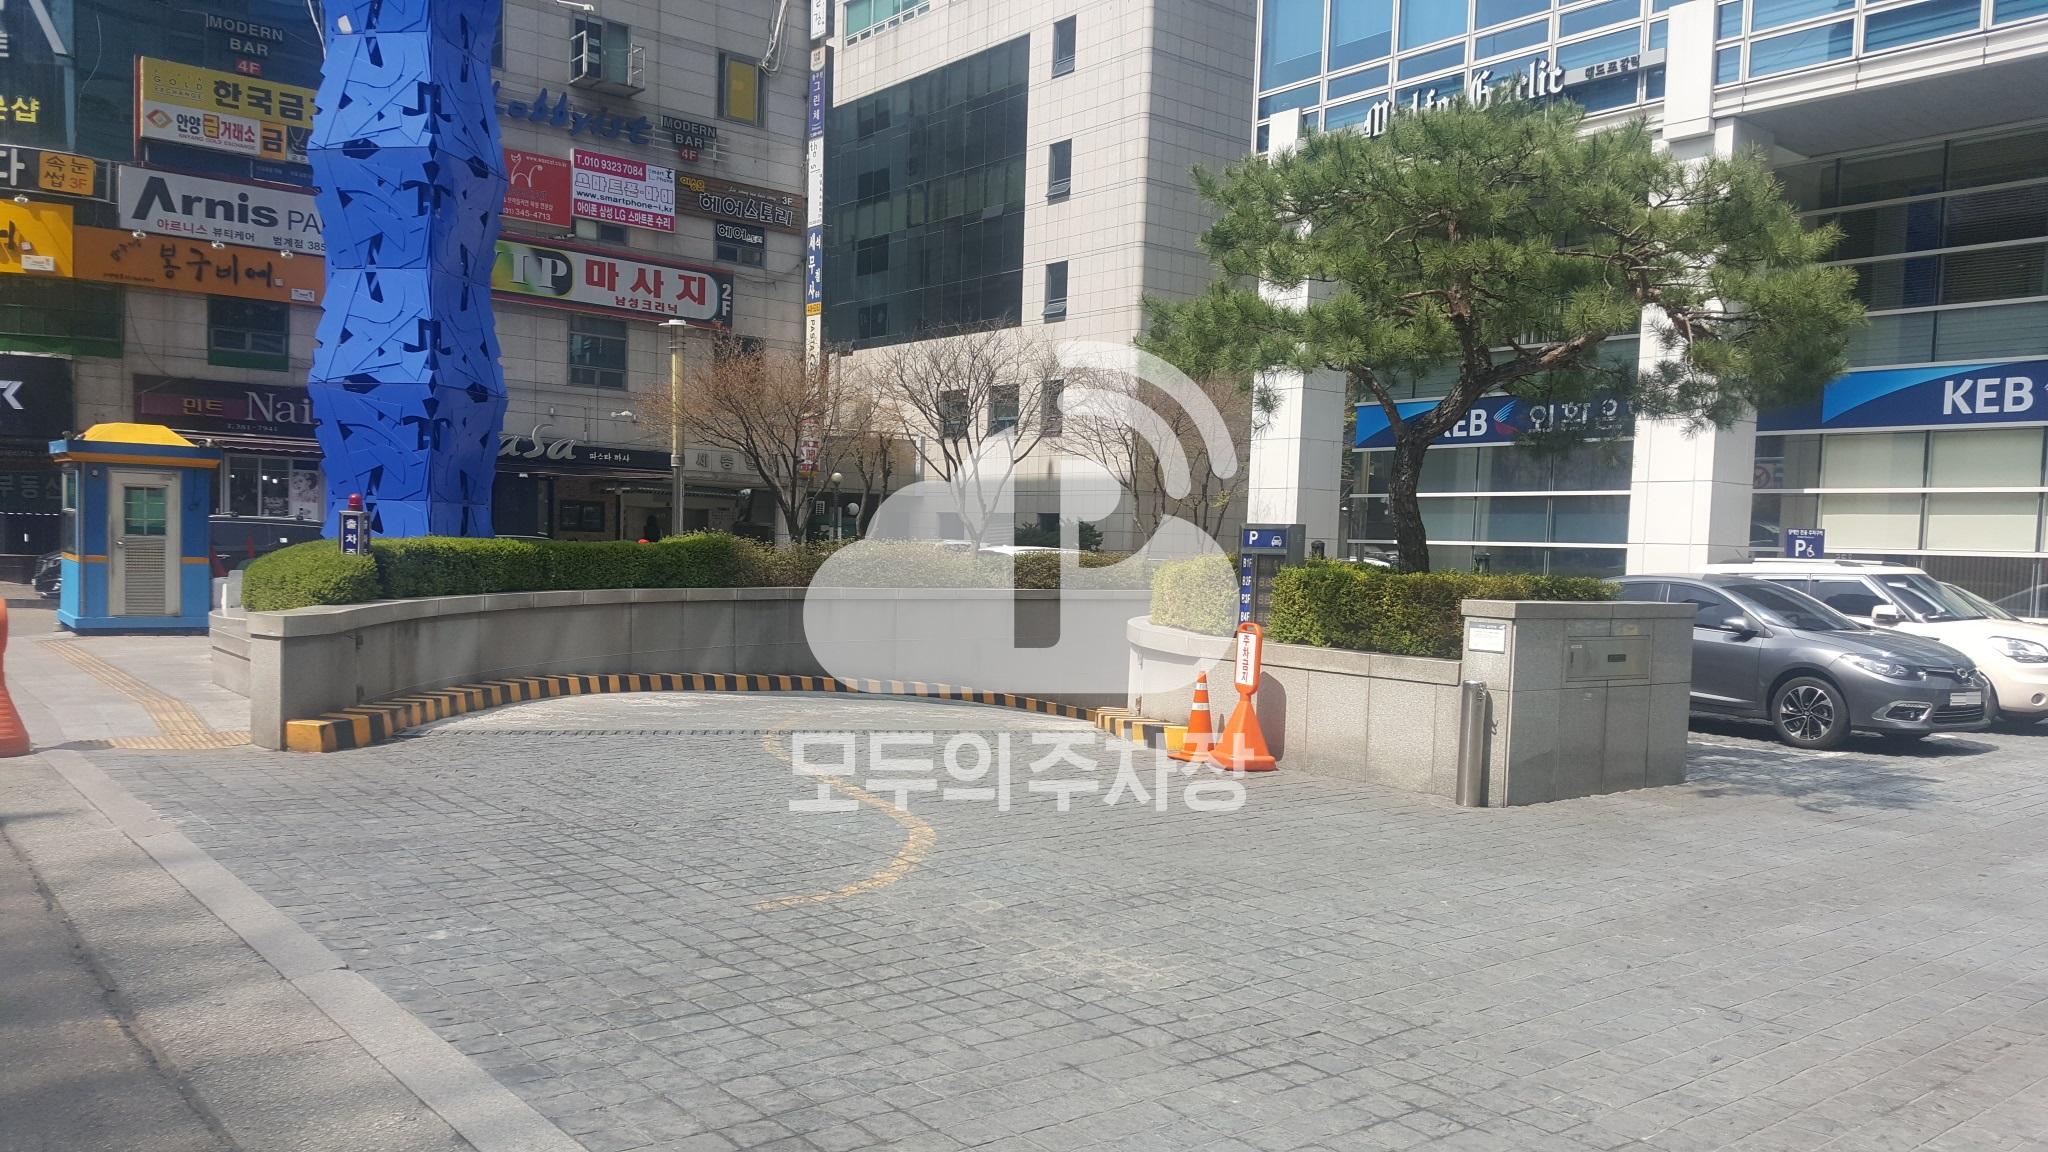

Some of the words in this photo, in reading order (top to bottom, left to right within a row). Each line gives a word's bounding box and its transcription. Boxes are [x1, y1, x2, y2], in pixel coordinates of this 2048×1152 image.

[208, 15, 284, 41] MODERN
[229, 37, 269, 57] BAR
[238, 60, 261, 74] 4F
[176, 113, 256, 144] 안양금거래소
[662, 115, 717, 138] MODERN
[675, 133, 704, 148] BAR
[681, 148, 698, 160] 4F
[601, 159, 622, 173] 9323
[623, 163, 644, 177] 7084
[70, 177, 88, 190] 3F
[131, 175, 279, 229] Arnis
[576, 189, 673, 213] www.smartphone-i.kr
[699, 192, 793, 227] 헤어스토리
[781, 196, 793, 206] 3F
[577, 201, 598, 216] 아이폰
[600, 203, 613, 219] 삼성
[614, 208, 626, 221] LG
[627, 210, 654, 227] 스마트폰
[656, 215, 671, 230] 수리
[156, 218, 208, 236] 아르니스
[212, 226, 256, 242] 뷰티케어
[272, 235, 304, 249] 범계점
[585, 258, 706, 306] 마사지
[615, 296, 678, 315] 남성크리닉
[1942, 375, 2034, 416] KEB
[183, 398, 225, 418] 민트
[1443, 408, 1488, 438] EB
[588, 452, 612, 462] 파스타
[1248, 530, 1259, 545] P
[1795, 539, 1807, 557] P
[1241, 635, 1250, 683] 주차금지
